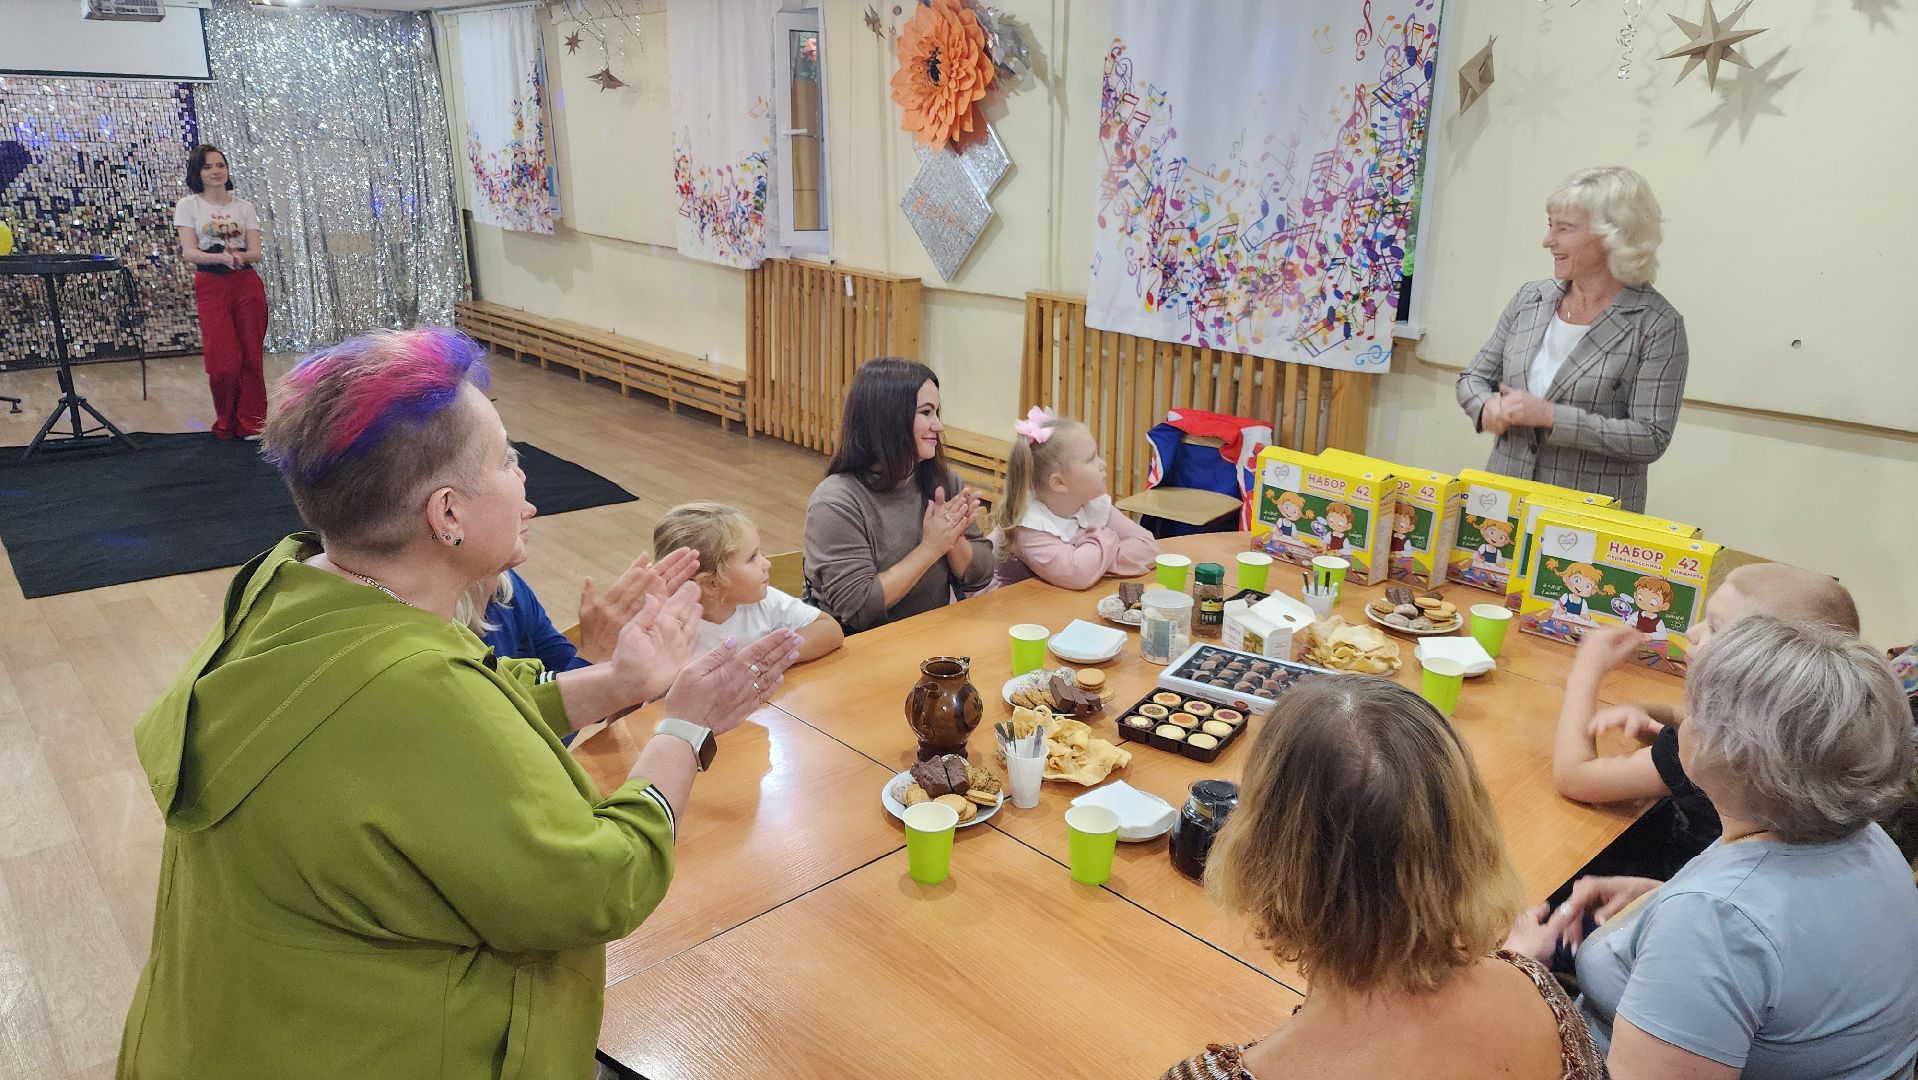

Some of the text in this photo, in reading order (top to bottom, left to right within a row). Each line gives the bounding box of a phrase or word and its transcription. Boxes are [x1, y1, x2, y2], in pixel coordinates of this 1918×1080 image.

[1308, 473, 1346, 490] НАБОР
[1355, 485, 1370, 497] 42
[1420, 486, 1435, 498] 42
[1609, 541, 1664, 563] НАБОР
[1678, 557, 1699, 572] 42
